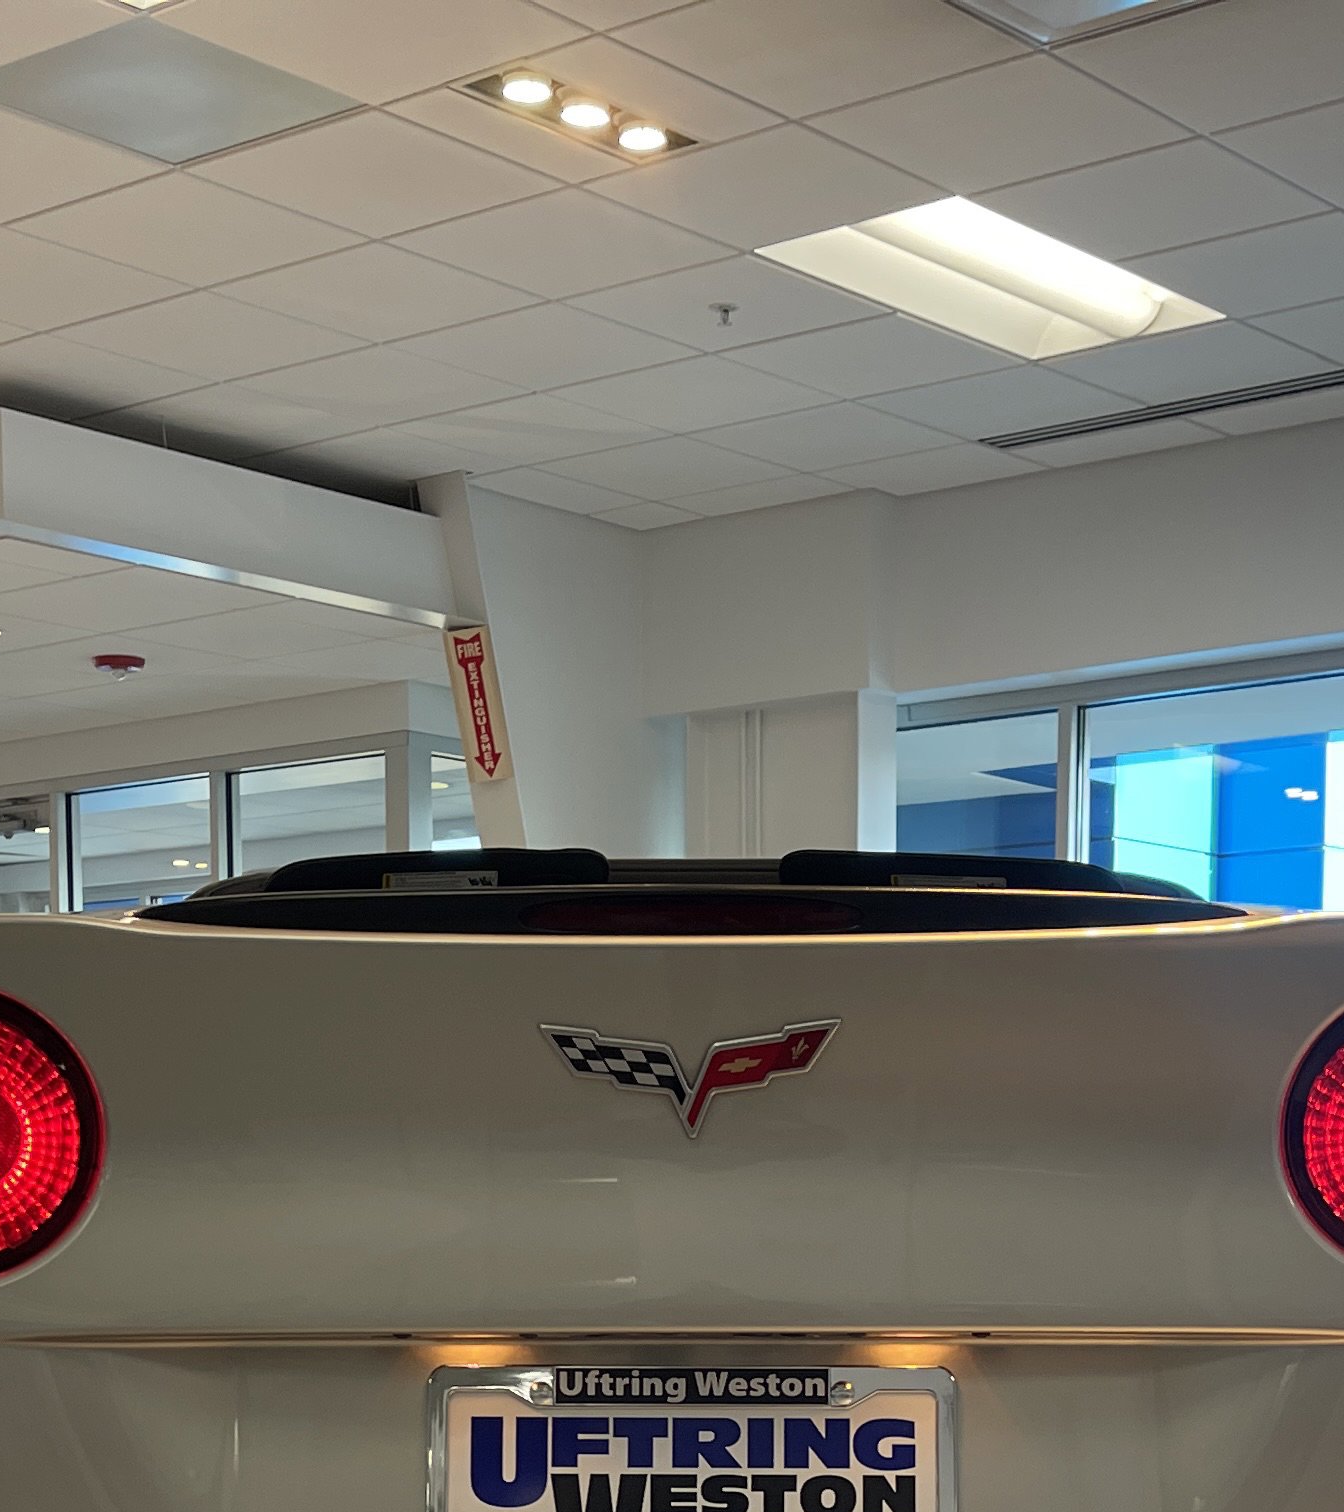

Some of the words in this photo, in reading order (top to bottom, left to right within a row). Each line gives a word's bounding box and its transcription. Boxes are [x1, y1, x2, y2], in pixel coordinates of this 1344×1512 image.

[456, 641, 483, 660] FIRE
[467, 661, 495, 770] EXTINGUISHER
[559, 1369, 687, 1403] Uftring
[694, 1370, 826, 1398] Weston
[470, 1415, 916, 1508] UFTRING
